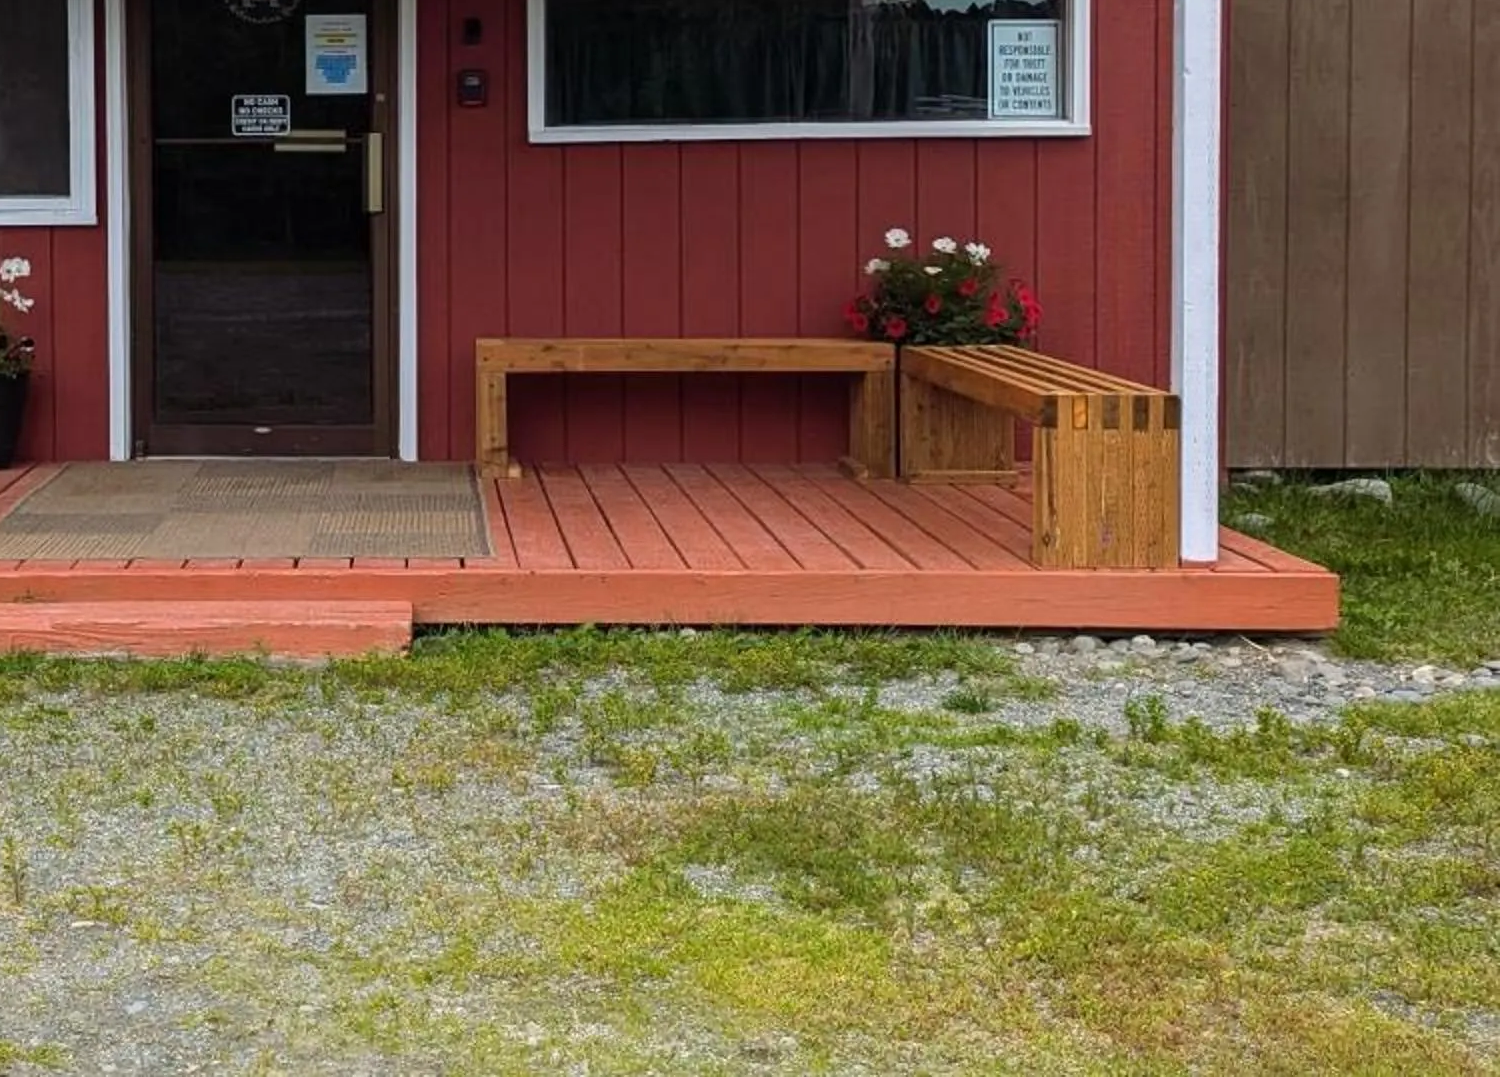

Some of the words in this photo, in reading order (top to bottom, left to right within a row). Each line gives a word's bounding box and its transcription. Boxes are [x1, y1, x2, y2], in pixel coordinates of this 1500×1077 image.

[999, 44, 1051, 56] RESPONSIBLE
[1015, 72, 1047, 83] DAMAGE
[1011, 85, 1051, 97] VEHICLES
[1011, 98, 1052, 110] CONTENTS
